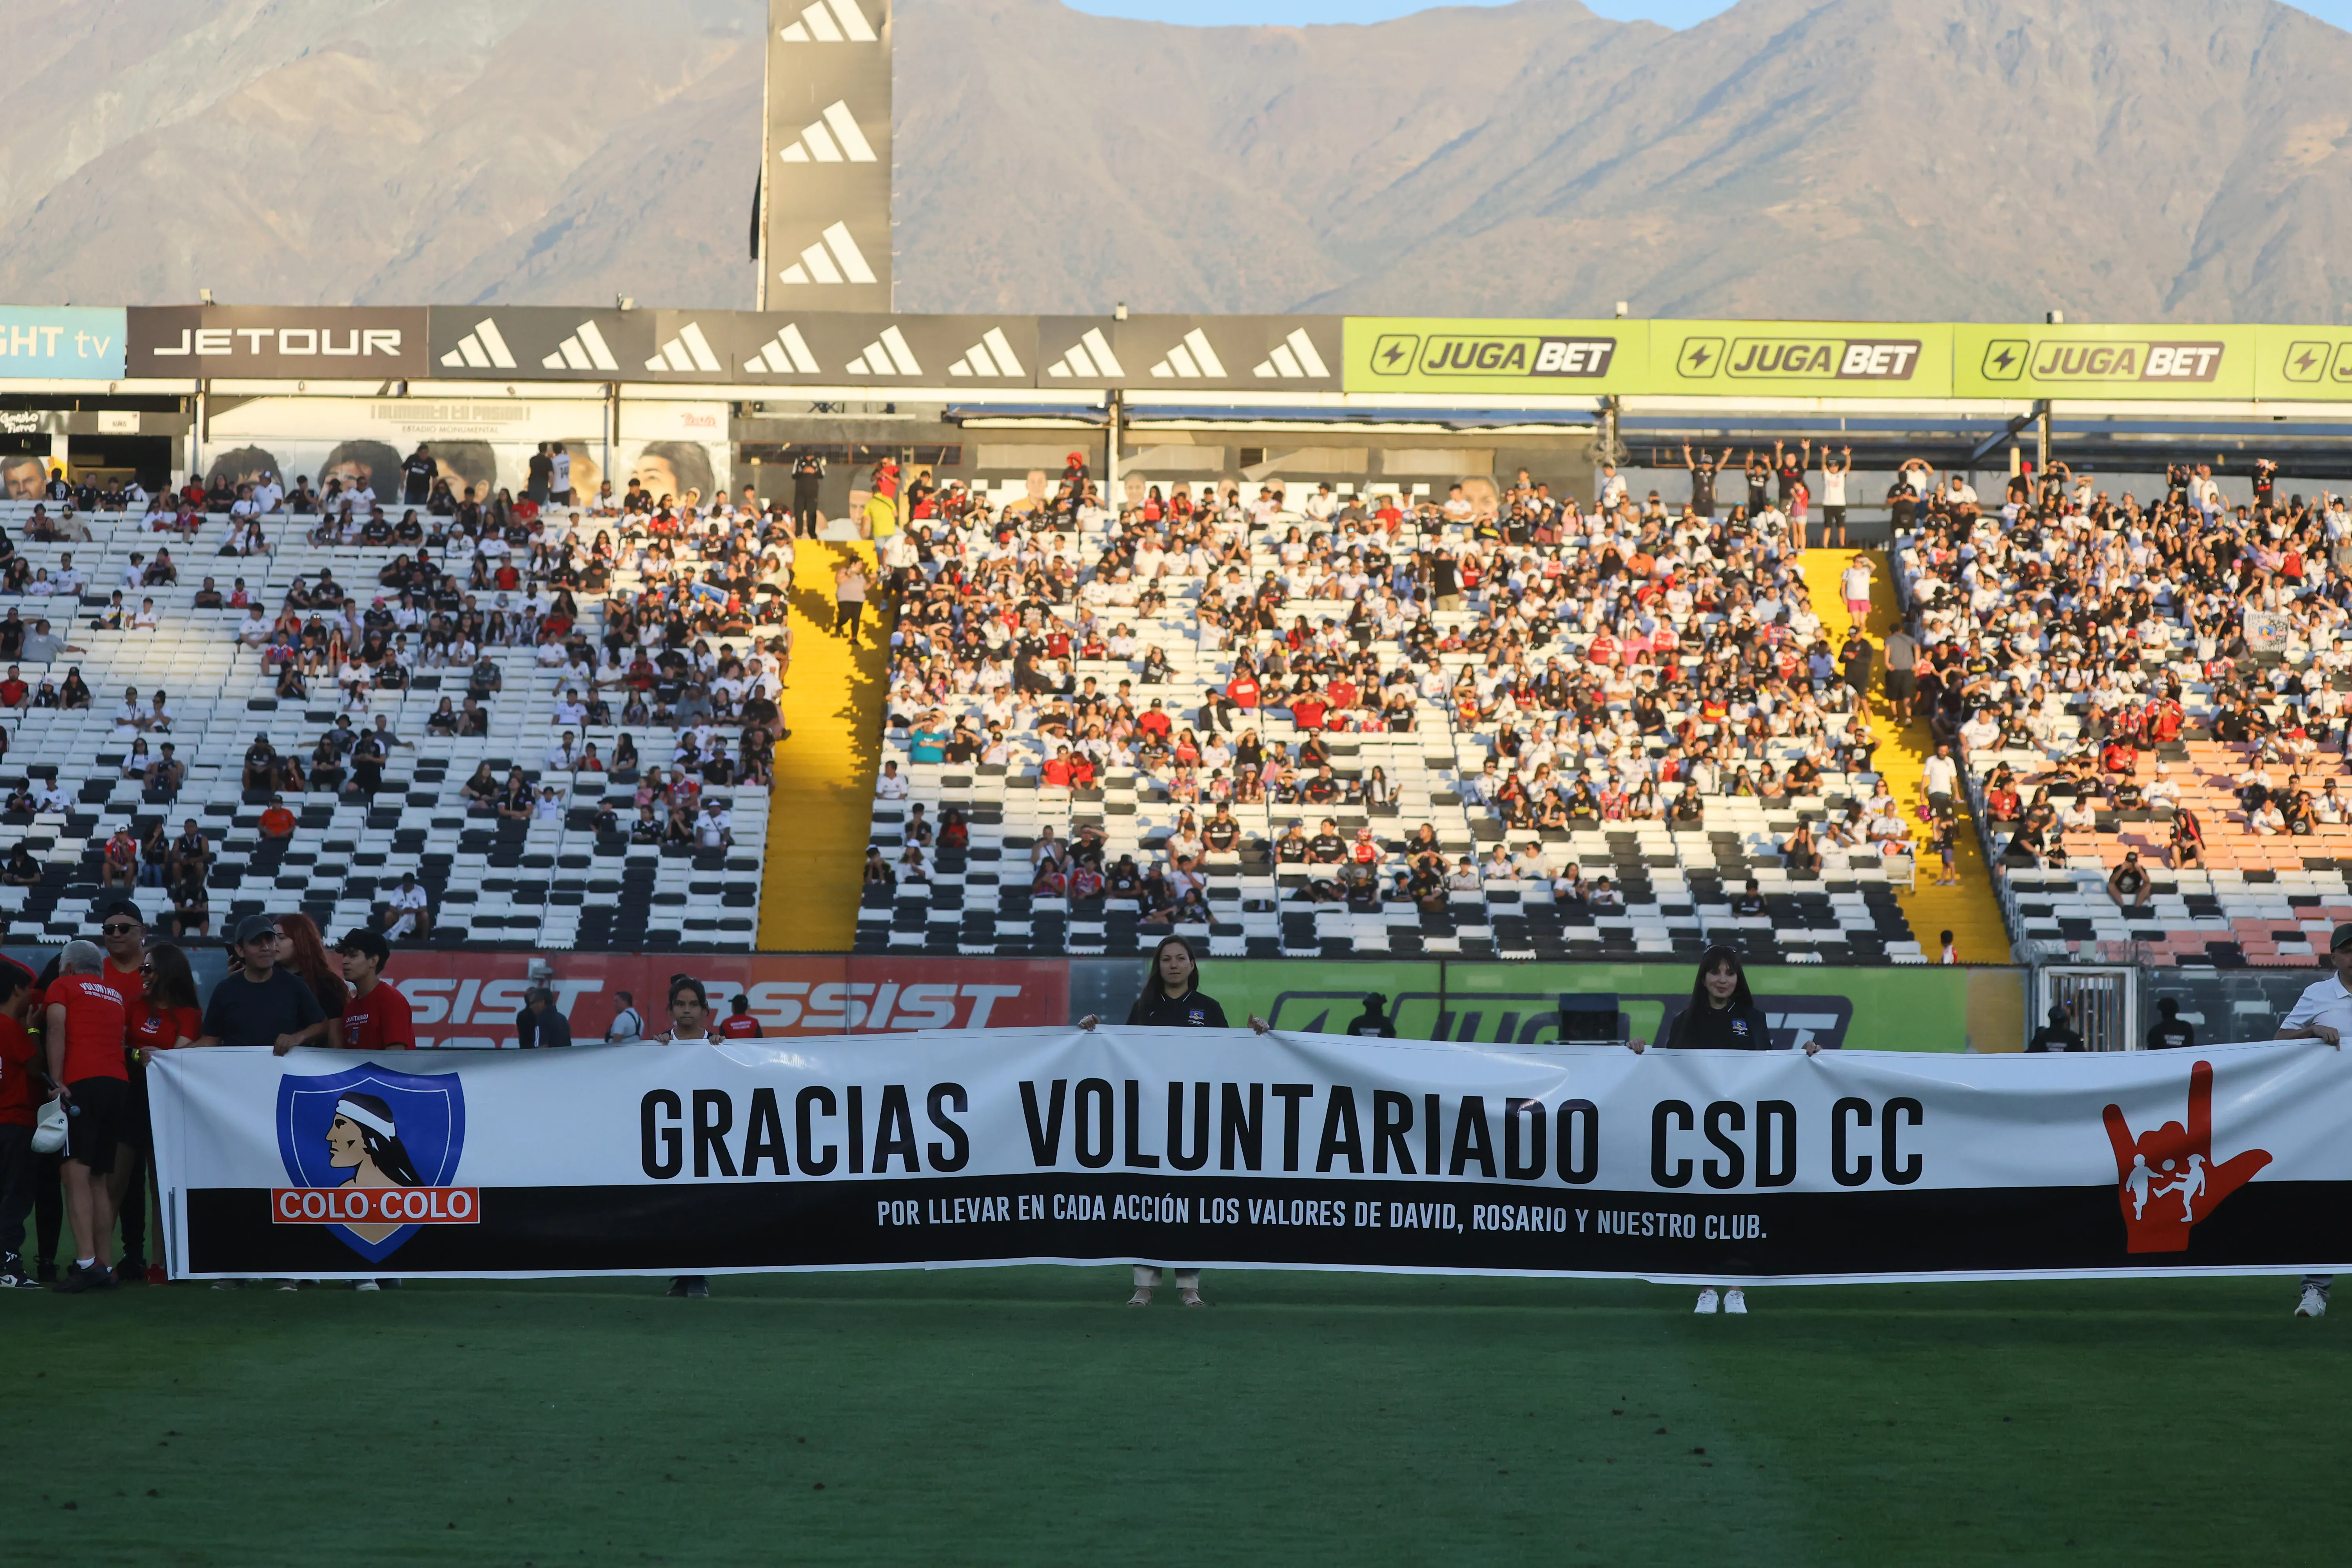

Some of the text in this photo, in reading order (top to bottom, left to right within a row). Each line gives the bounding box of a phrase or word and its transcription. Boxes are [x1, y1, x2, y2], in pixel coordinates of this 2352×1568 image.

[0, 325, 111, 358] HT tv
[154, 328, 401, 356] JETOUR
[439, 425, 499, 434] MONUMENTAL
[384, 978, 604, 1024] SIST
[641, 1078, 1923, 1189] GRACIAS VOLUNTARIADO CSD CC
[878, 1193, 1767, 1240] POR LLEVAR EN CADA ACCIÓN LOS VALORES DE DAVID, ROSARIO Y NUESTRO CLUB.
